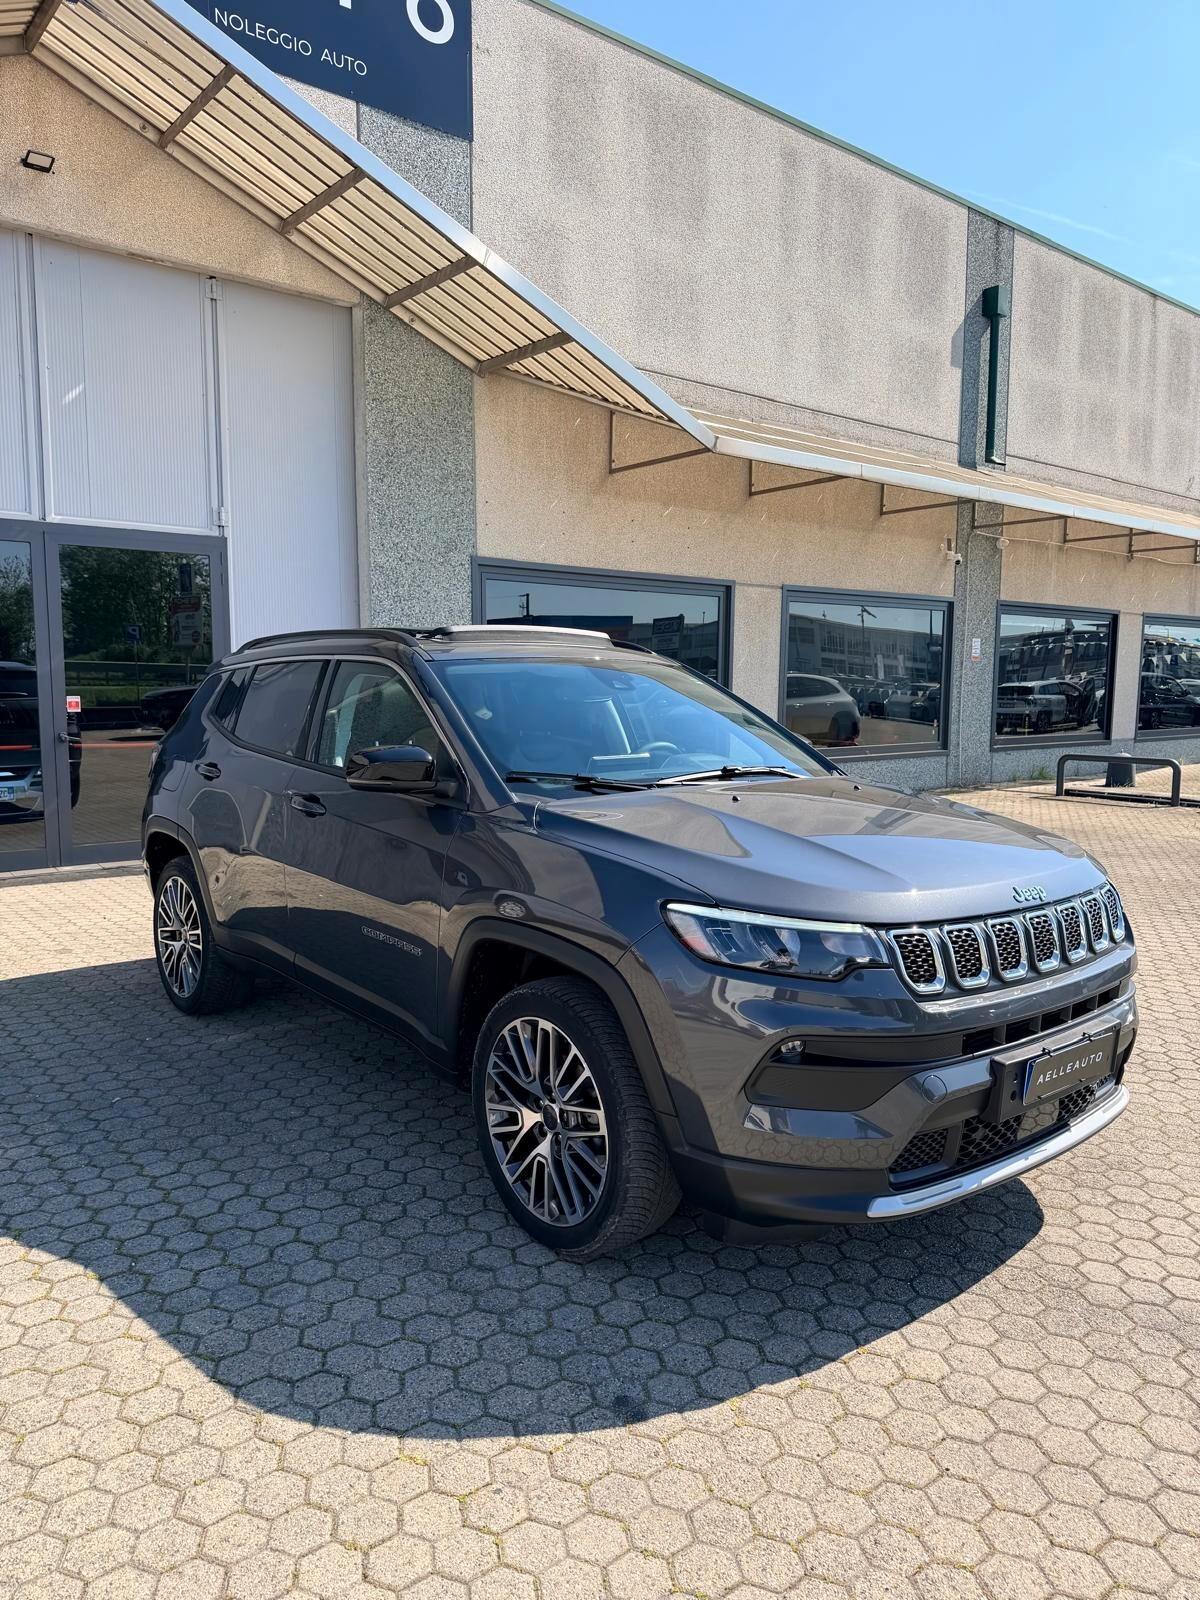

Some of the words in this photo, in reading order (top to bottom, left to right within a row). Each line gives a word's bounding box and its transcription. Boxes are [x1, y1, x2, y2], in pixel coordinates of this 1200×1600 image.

[214, 7, 312, 56] NOLEGGIO
[320, 48, 367, 76] AUTO
[1012, 886, 1047, 903] Jeep
[361, 925, 422, 957] COMPASS
[1036, 1051, 1103, 1086] AELLEAUTO
